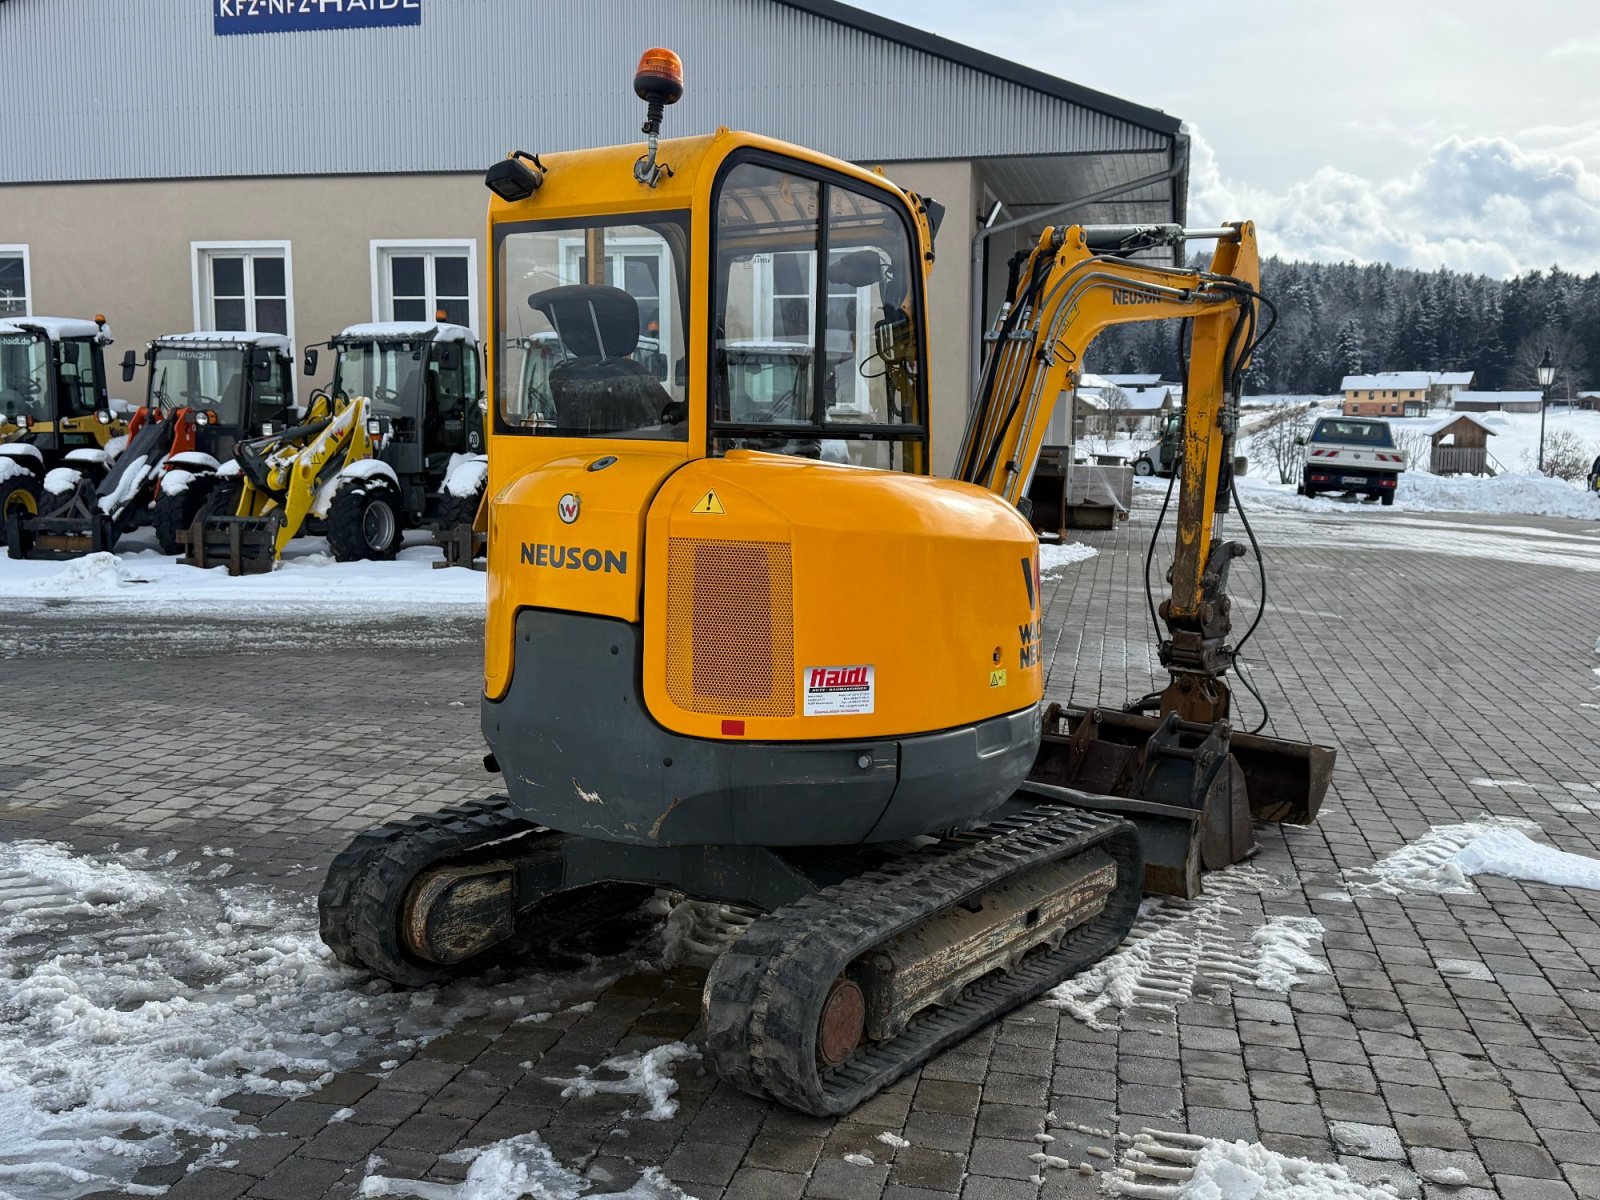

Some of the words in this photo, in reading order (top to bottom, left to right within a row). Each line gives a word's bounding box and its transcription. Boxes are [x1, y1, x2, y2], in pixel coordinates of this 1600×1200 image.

[1112, 288, 1161, 305] NEUSON
[520, 542, 627, 574] NEUSON
[810, 667, 869, 687] Haidl
